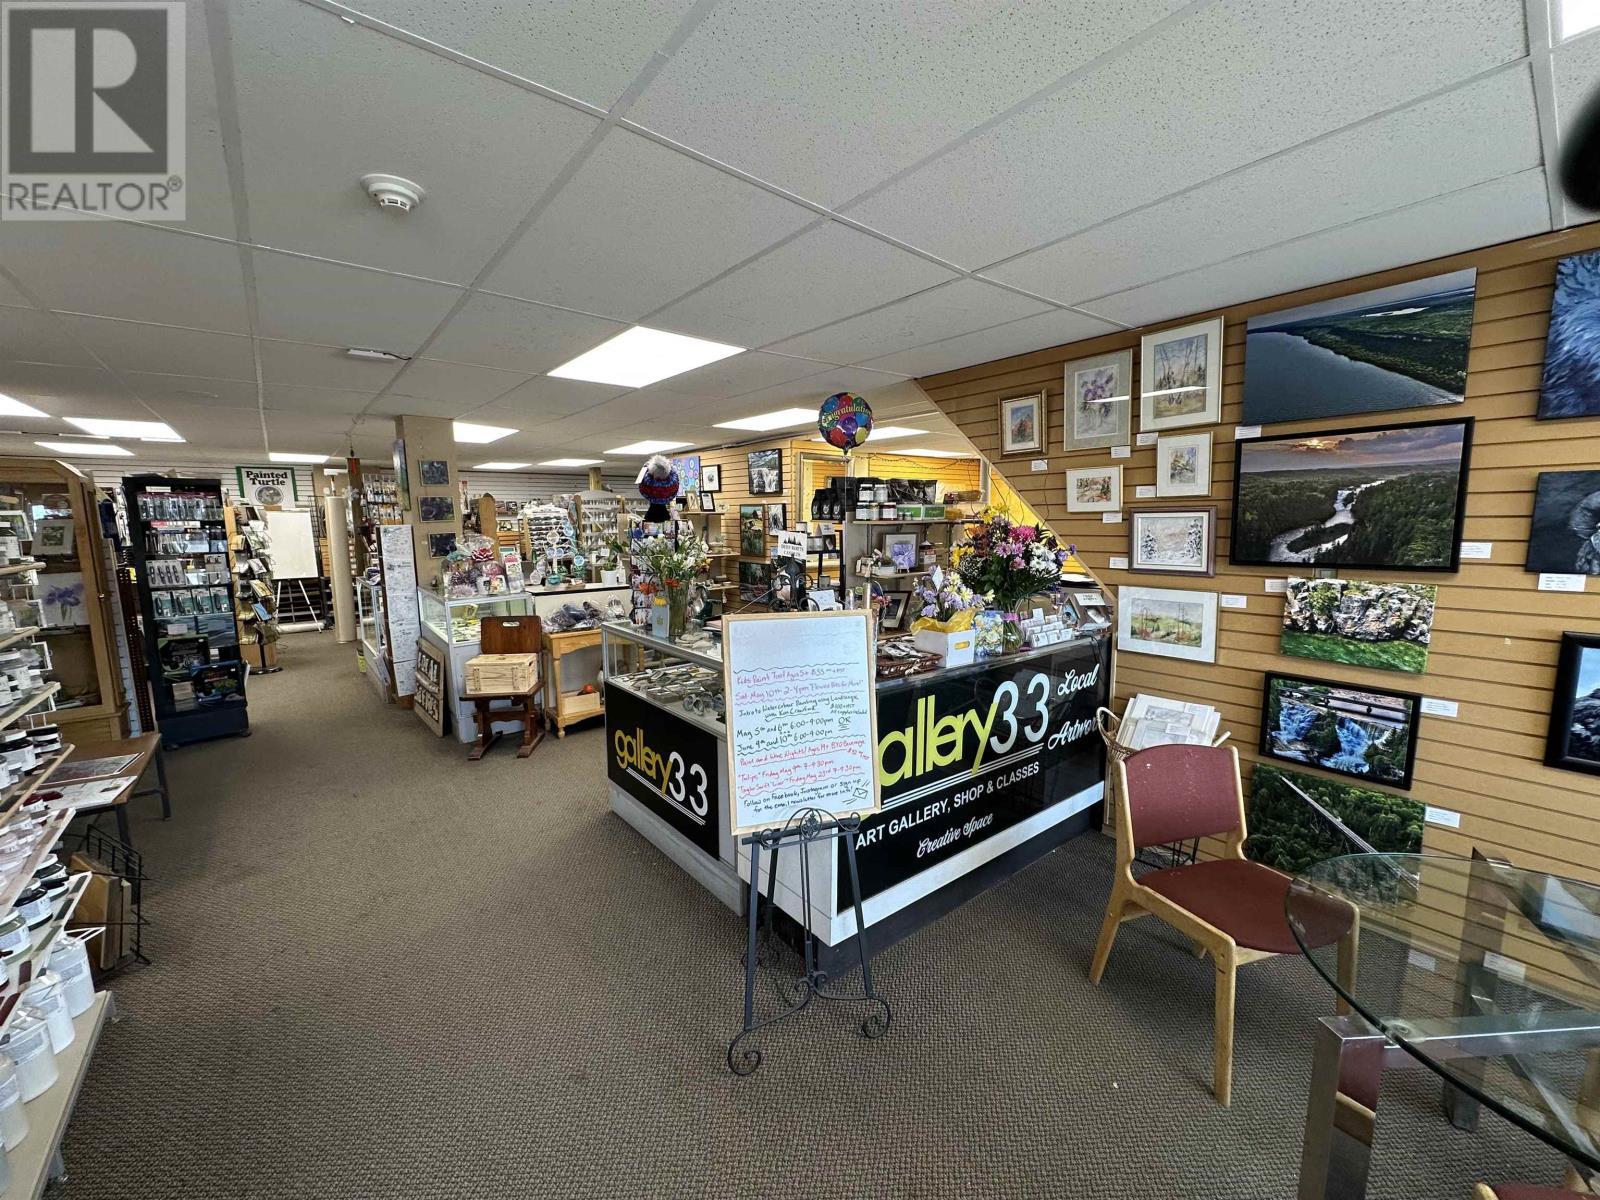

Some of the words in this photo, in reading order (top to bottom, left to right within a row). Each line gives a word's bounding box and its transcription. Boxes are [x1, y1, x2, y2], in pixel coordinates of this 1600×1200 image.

[245, 471, 288, 479] Painted
[250, 478, 286, 486] Turtle
[1057, 663, 1100, 696] Local
[737, 729, 753, 740] May
[878, 673, 1050, 787] allery33
[737, 744, 754, 752] June
[766, 737, 778, 747] and
[744, 800, 762, 808] Follow
[856, 823, 887, 851] ART
[888, 797, 951, 835] GALLERY,
[953, 785, 985, 808] SHOP
[986, 782, 994, 795] &
[996, 761, 1040, 790] CLASSES
[916, 825, 962, 859] Creative
[962, 812, 994, 844] Space
